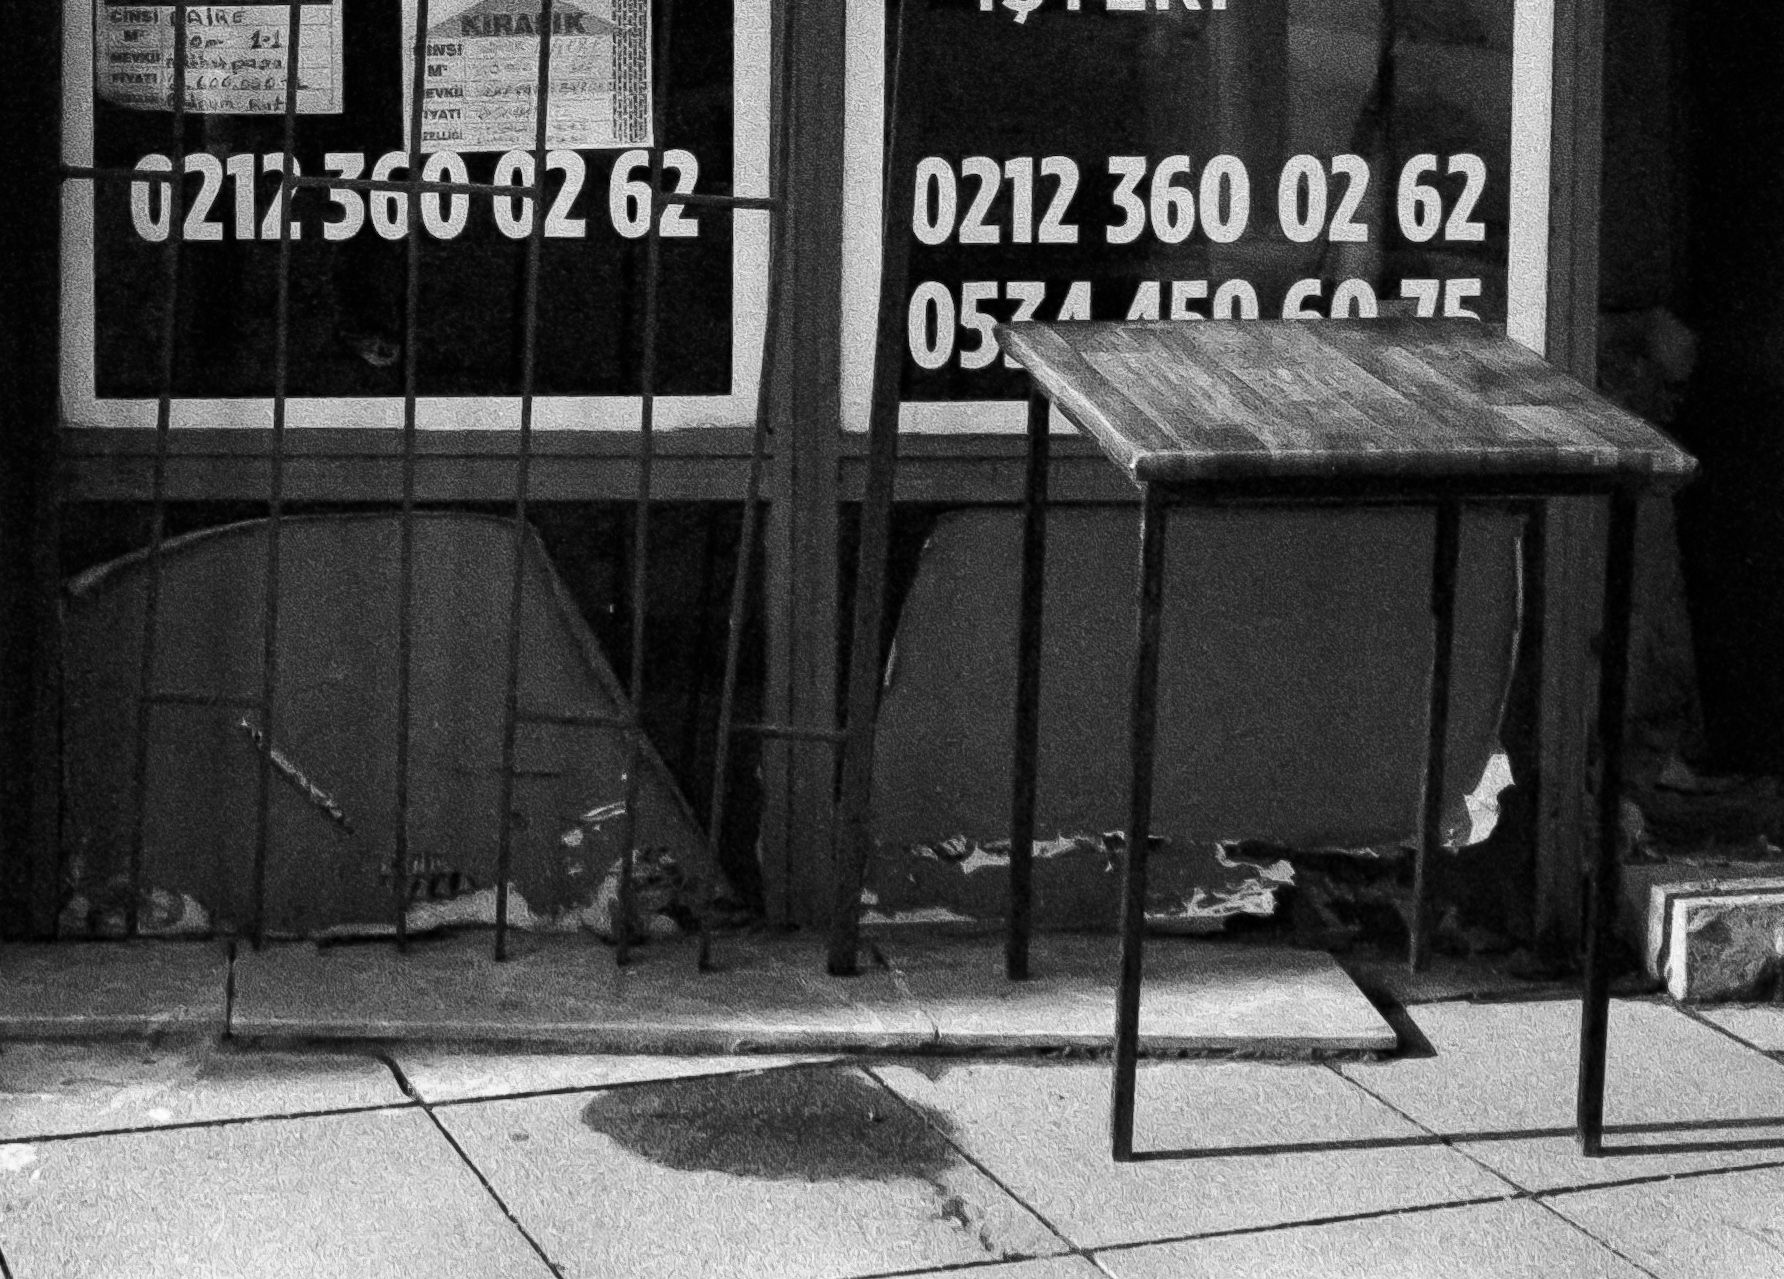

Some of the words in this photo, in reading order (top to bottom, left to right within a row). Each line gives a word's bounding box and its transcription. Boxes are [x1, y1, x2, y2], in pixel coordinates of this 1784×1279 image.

[130, 152, 302, 242] 0212
[323, 151, 471, 241] 360
[492, 150, 587, 240] 02
[609, 149, 700, 239] 62
[912, 155, 1081, 245] 0212
[1105, 153, 1252, 244] 360
[1277, 153, 1371, 243] 02
[1397, 152, 1487, 243] 62
